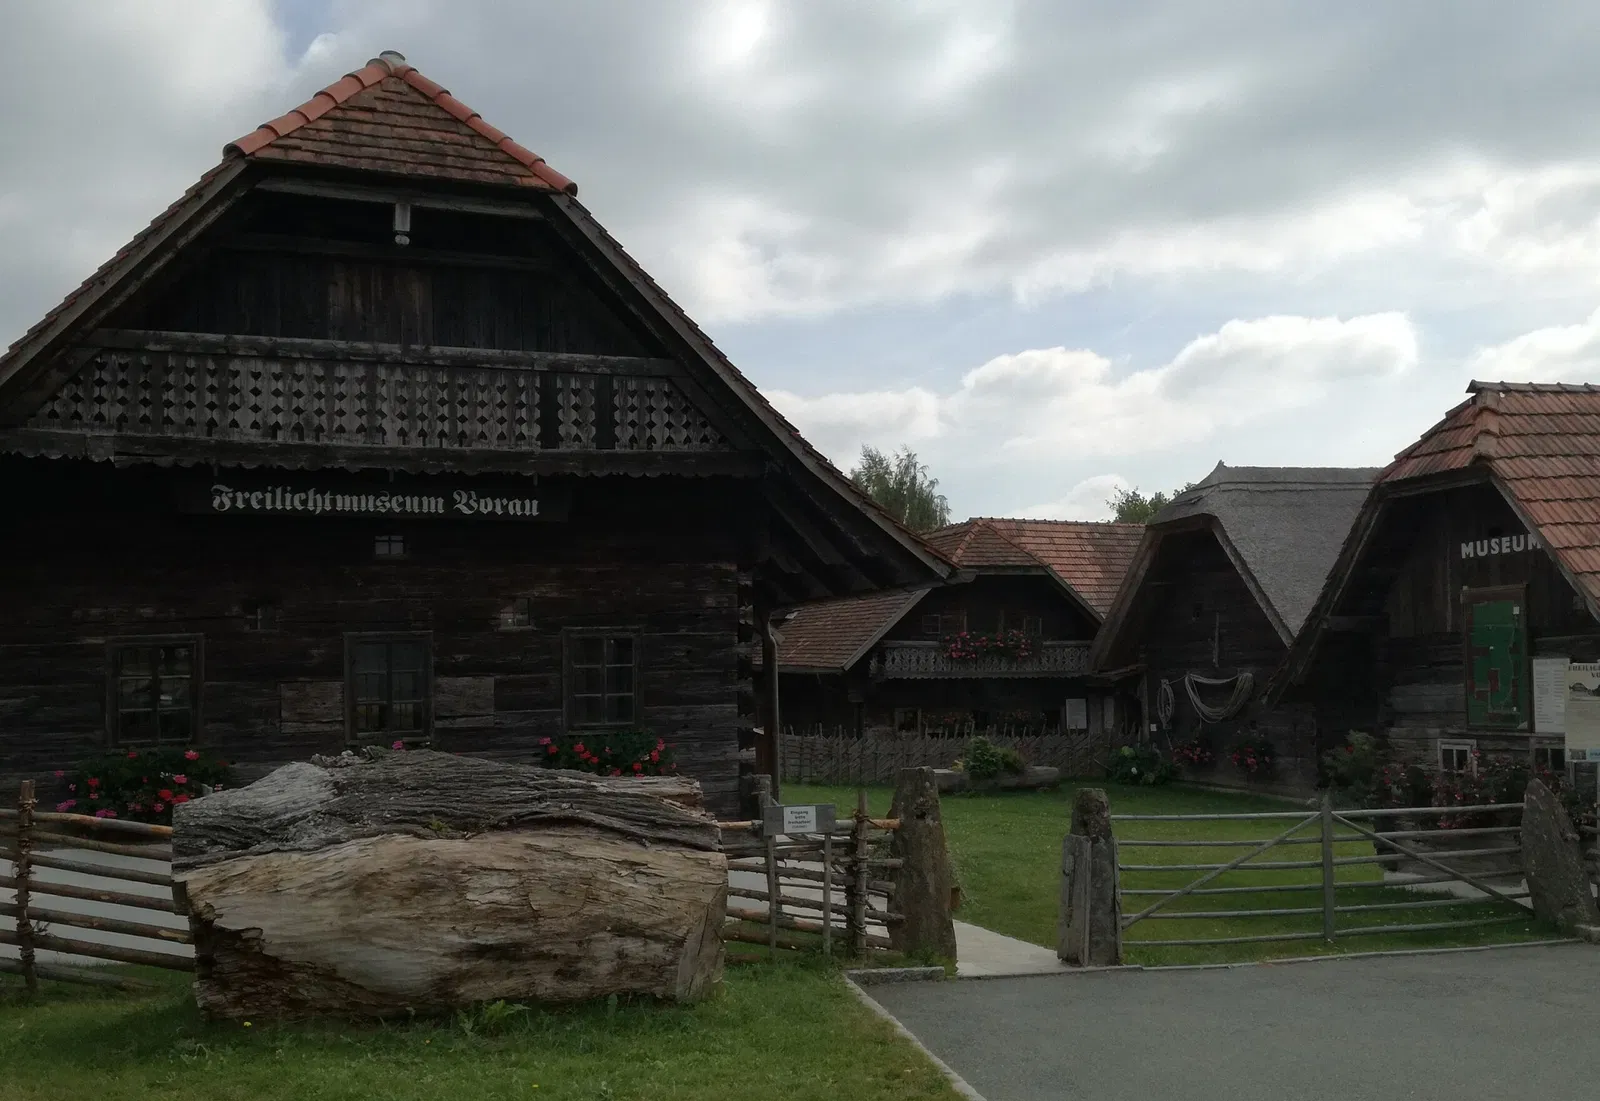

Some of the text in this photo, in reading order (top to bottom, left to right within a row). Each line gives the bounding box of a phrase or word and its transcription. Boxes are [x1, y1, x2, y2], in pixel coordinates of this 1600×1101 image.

[211, 484, 540, 517] Freilichtmuseum Vorau
[1461, 534, 1542, 559] MUSEUM
